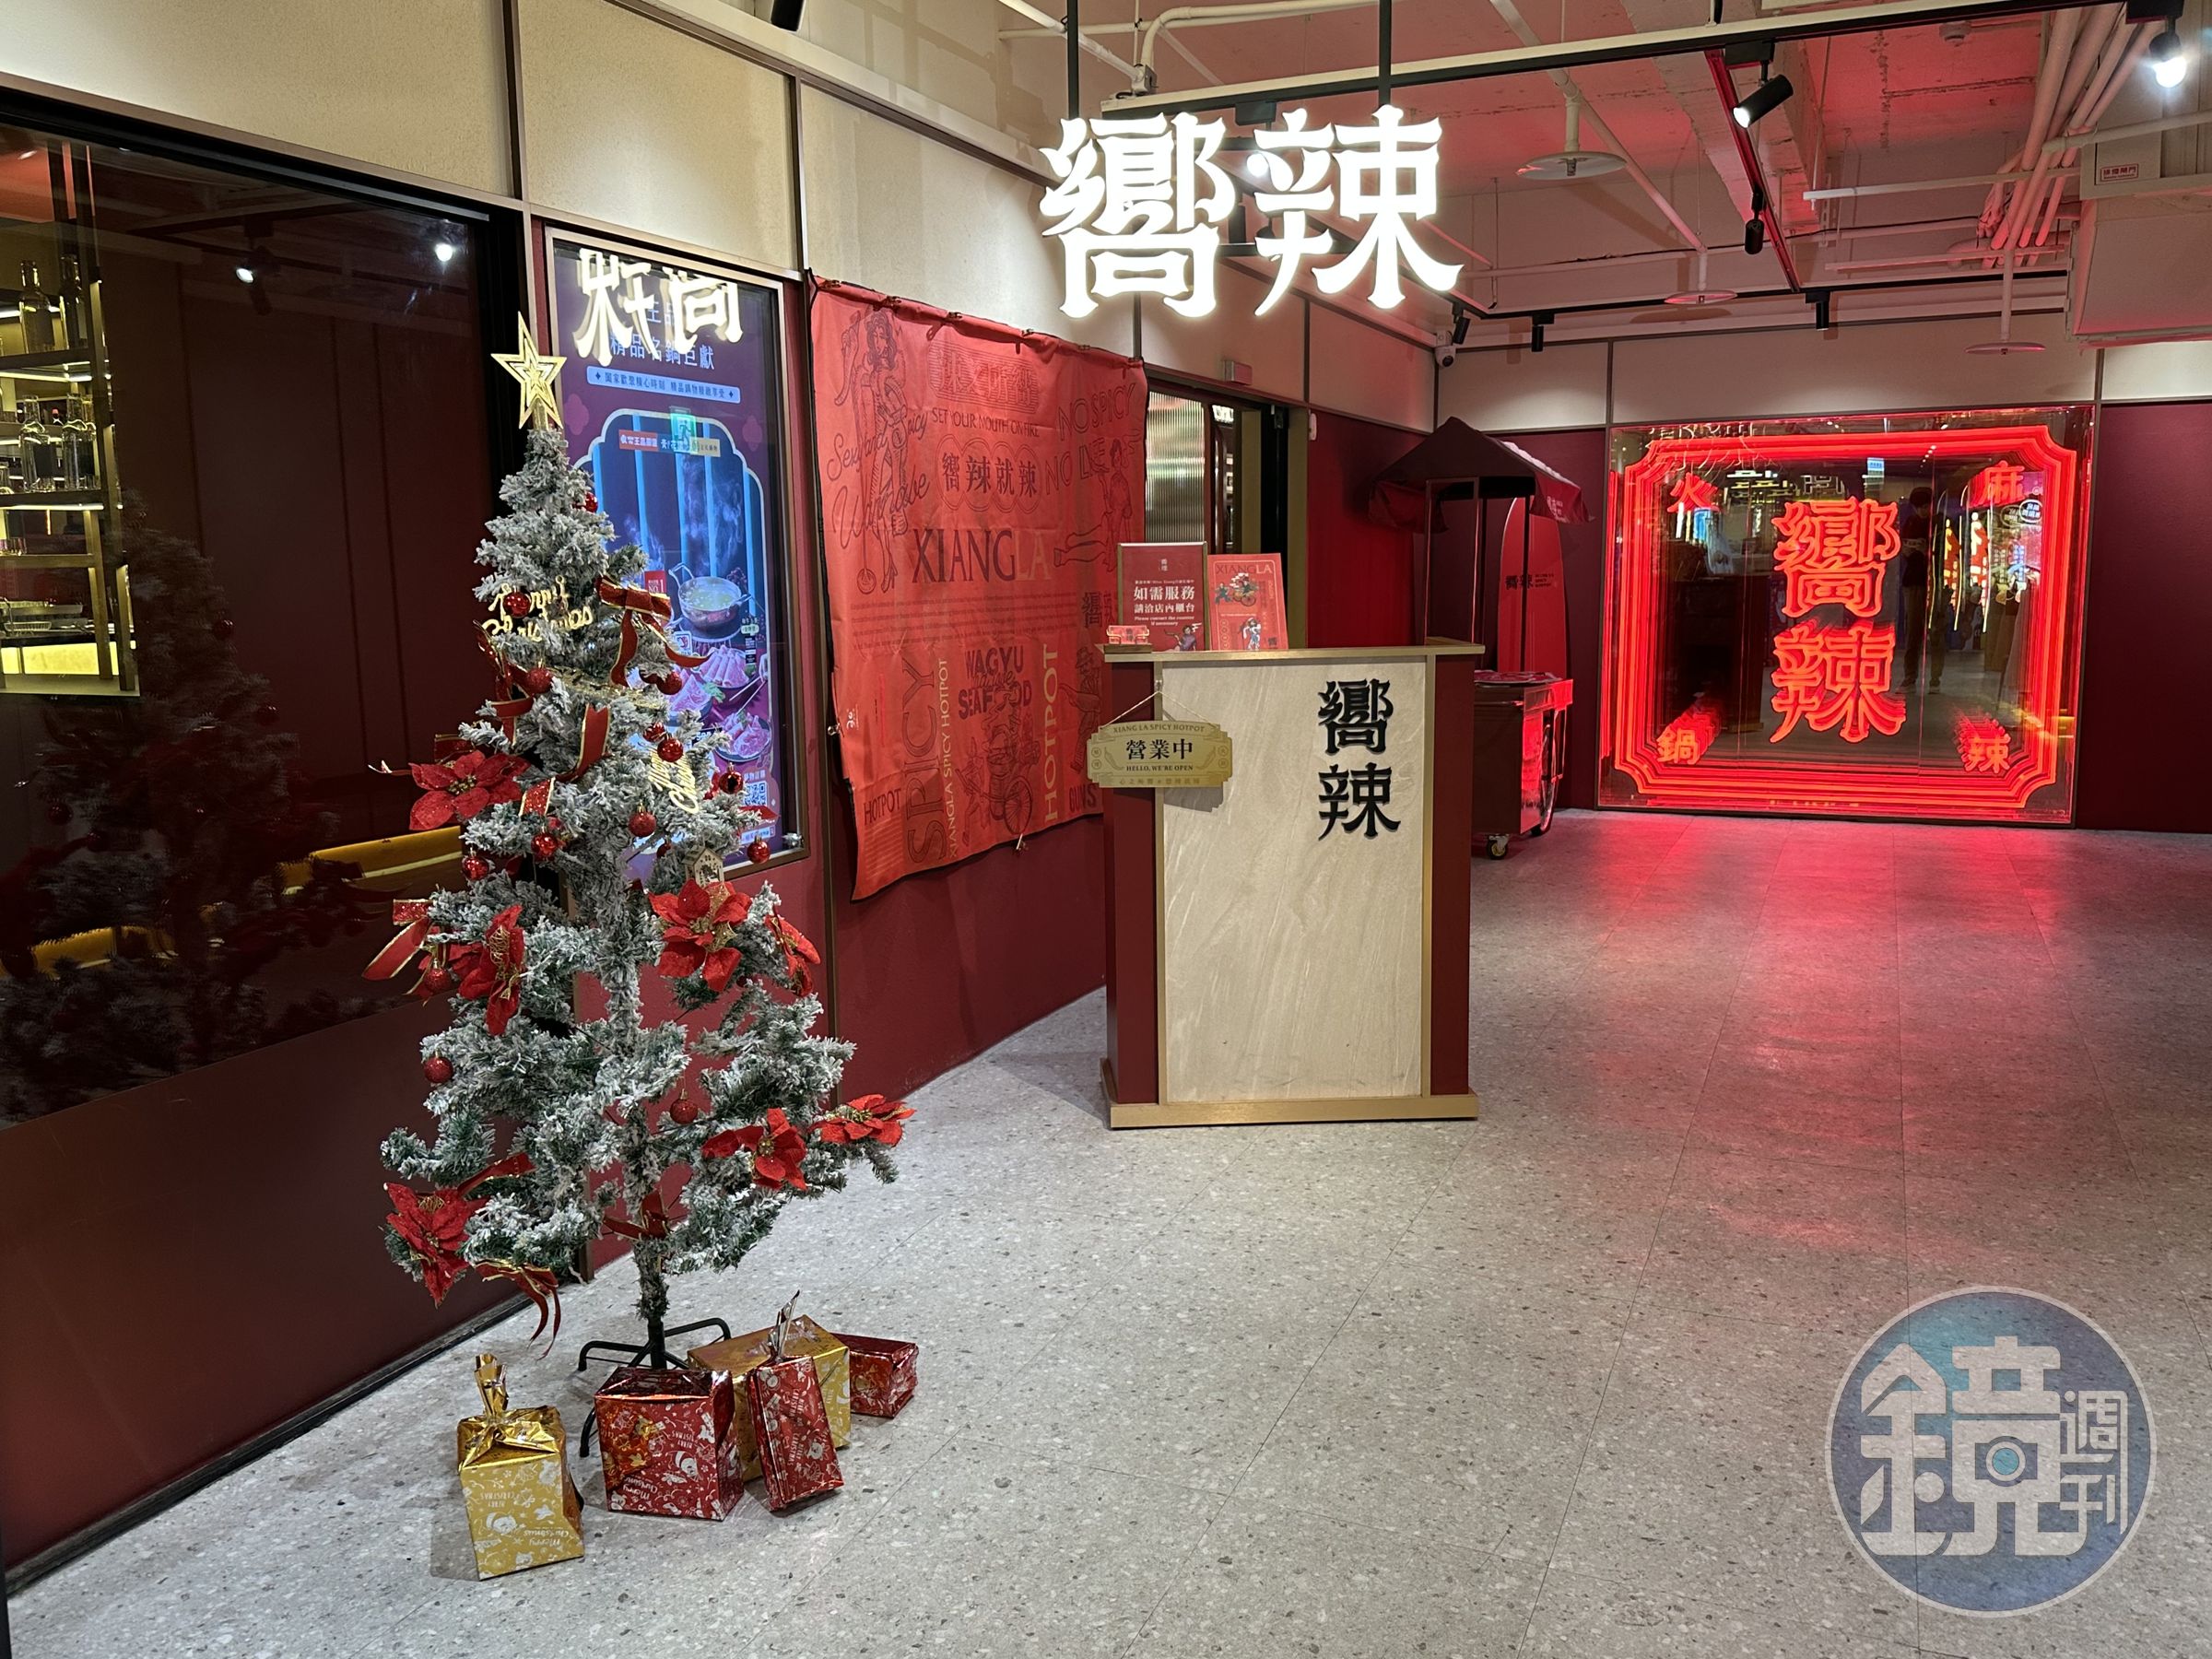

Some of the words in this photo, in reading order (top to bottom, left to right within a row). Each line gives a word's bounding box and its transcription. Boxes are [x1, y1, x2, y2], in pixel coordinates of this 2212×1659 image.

[1038, 104, 1465, 319] 嚮辣
[932, 406, 948, 424] SET
[1058, 398, 1088, 441] NO
[942, 452, 1038, 499] 嚮辣就辣
[1666, 472, 1719, 513] 火
[1980, 460, 2026, 504] 麻
[1134, 585, 1195, 601] 如需服務
[1134, 603, 1195, 614] 請洽店內櫃台
[964, 644, 1024, 679] WAGYU
[938, 658, 951, 727] HOTPOT
[1043, 643, 1060, 823] HOTPOT
[1113, 724, 1137, 733] XIANG
[1173, 724, 1206, 732] HOTPOT
[1126, 738, 1193, 760] 營業中
[1655, 726, 1700, 765] 鍋
[900, 653, 947, 864] SPICY
[941, 733, 953, 778] SPICY
[1318, 678, 1401, 841] 嚮辣
[1963, 734, 2011, 773] 辣
[863, 788, 902, 826] HOTPOT
